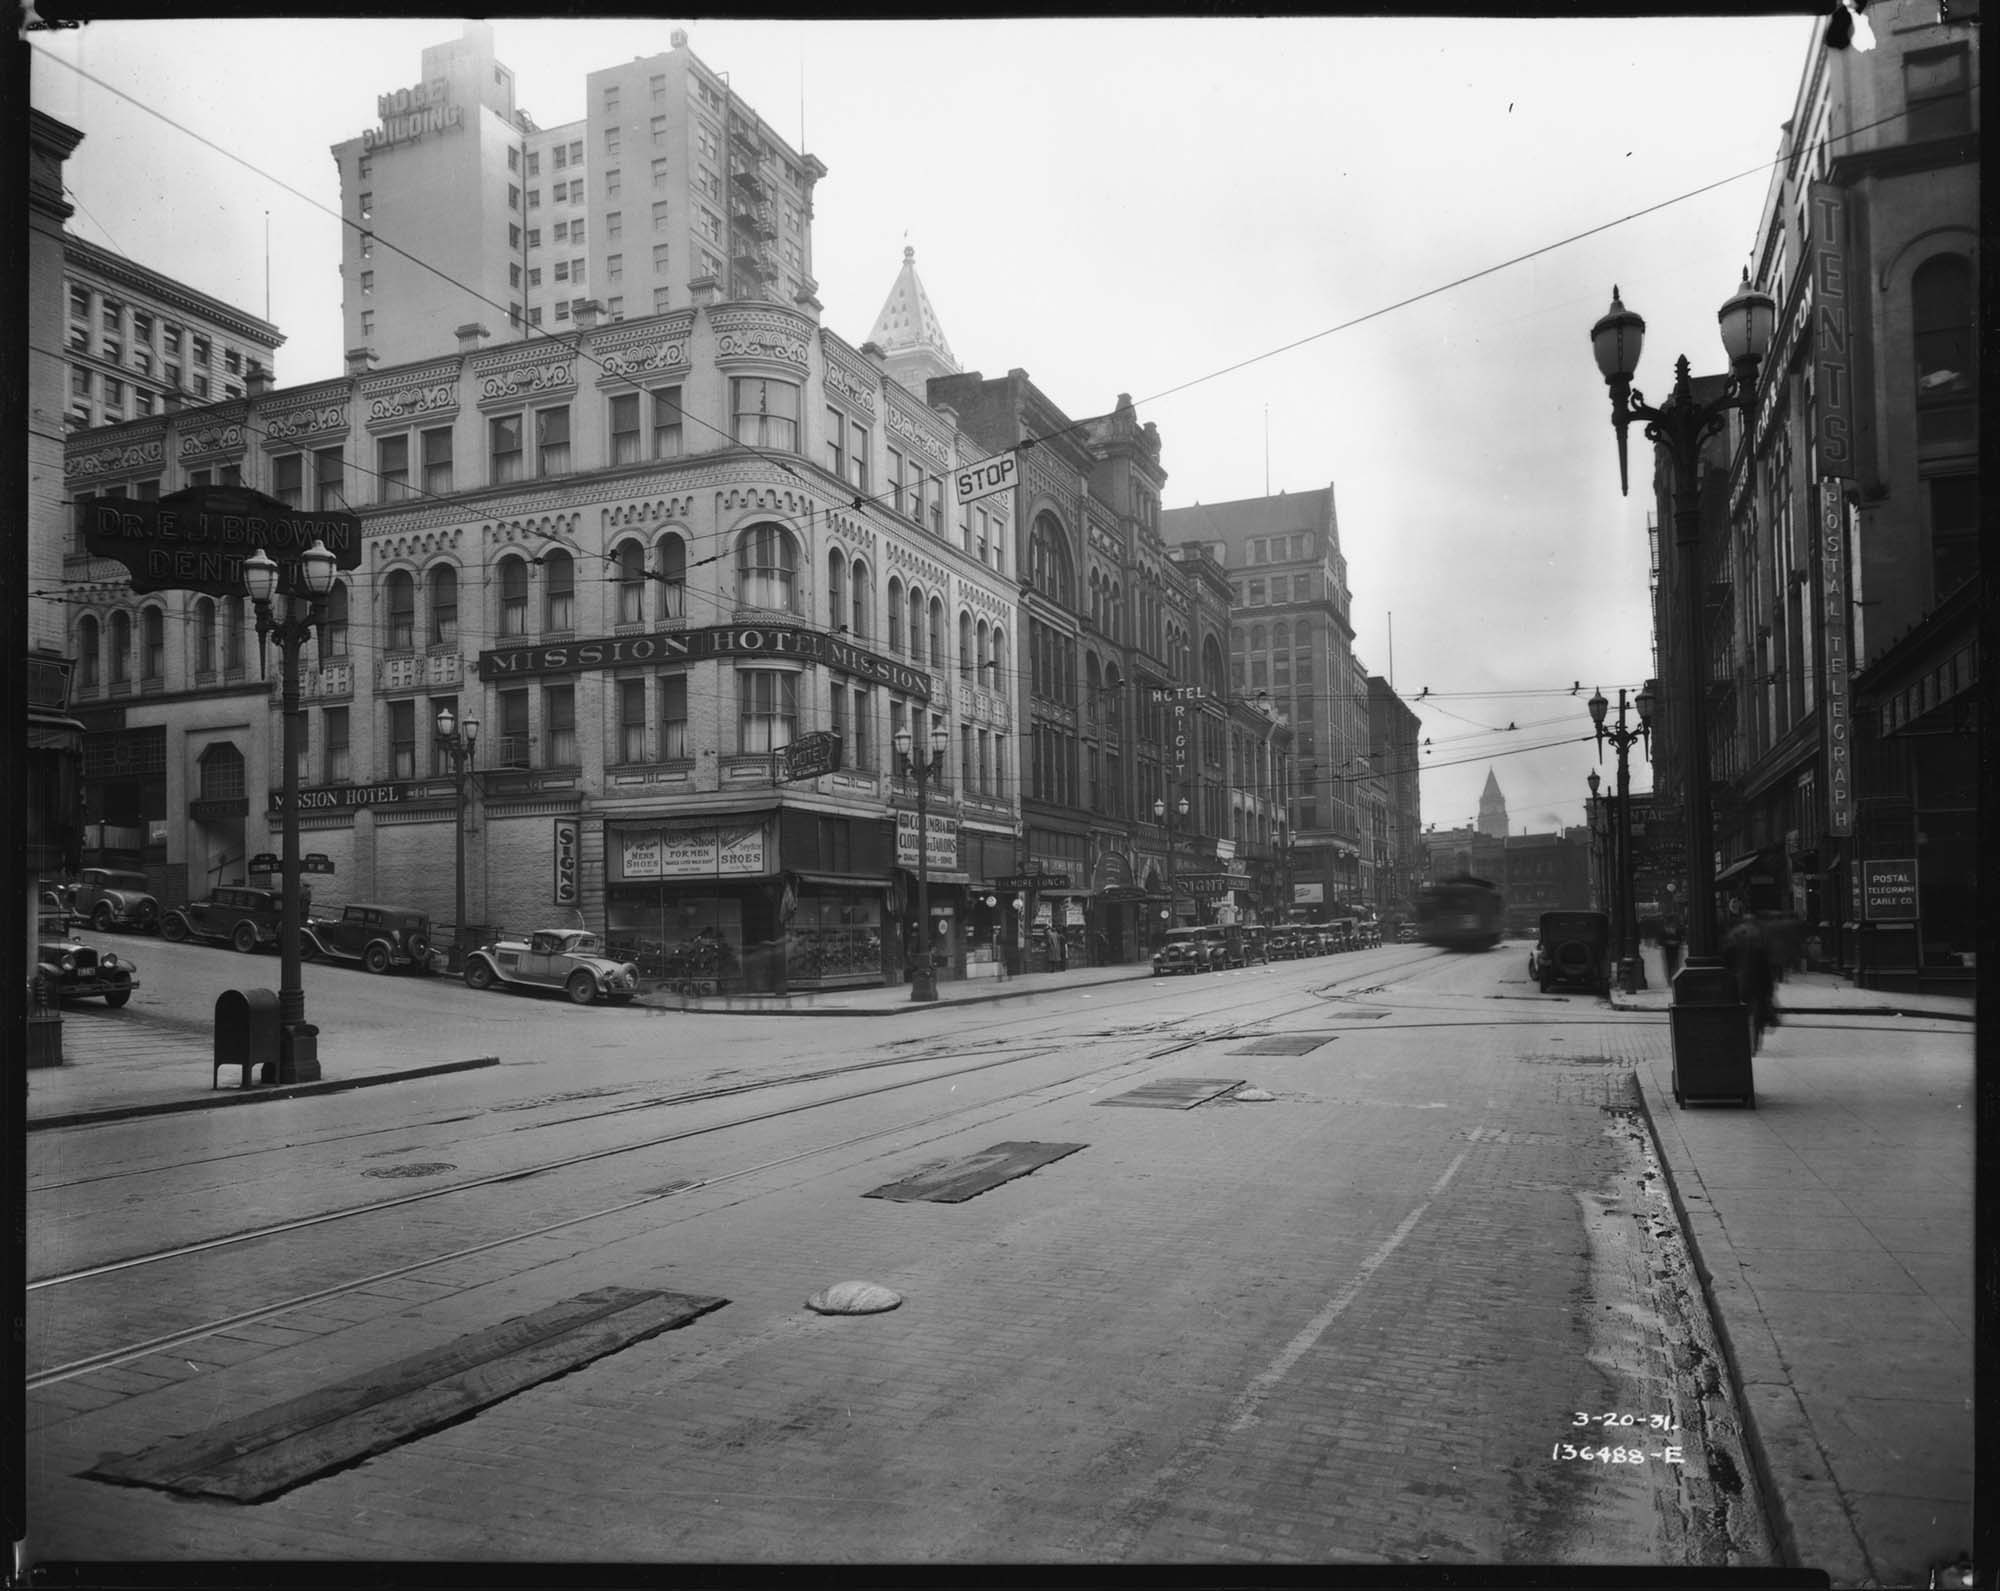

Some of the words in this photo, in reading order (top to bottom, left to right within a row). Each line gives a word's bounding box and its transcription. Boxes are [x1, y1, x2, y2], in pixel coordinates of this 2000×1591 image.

[362, 104, 464, 152] BUILDING
[1817, 197, 1850, 465] TENTS
[959, 459, 1014, 496] STOP
[223, 514, 349, 551] BROWN
[148, 549, 301, 586] DENTT
[1825, 492, 1841, 618] POSTAL
[491, 636, 691, 674] MISSION
[712, 630, 824, 657] HOTEL
[830, 642, 930, 697] MISSION
[1152, 688, 1206, 702] HOTEL
[1175, 706, 1185, 777] RIGHT
[1832, 635, 1849, 829] TELEGRAPH
[274, 791, 338, 811] MSSION
[347, 787, 399, 804] HOTEL
[559, 828, 574, 900] SIGNS
[721, 854, 761, 865] SHOES
[1872, 874, 1908, 884] POSTAL
[1868, 887, 1914, 895] TELEGRAPH
